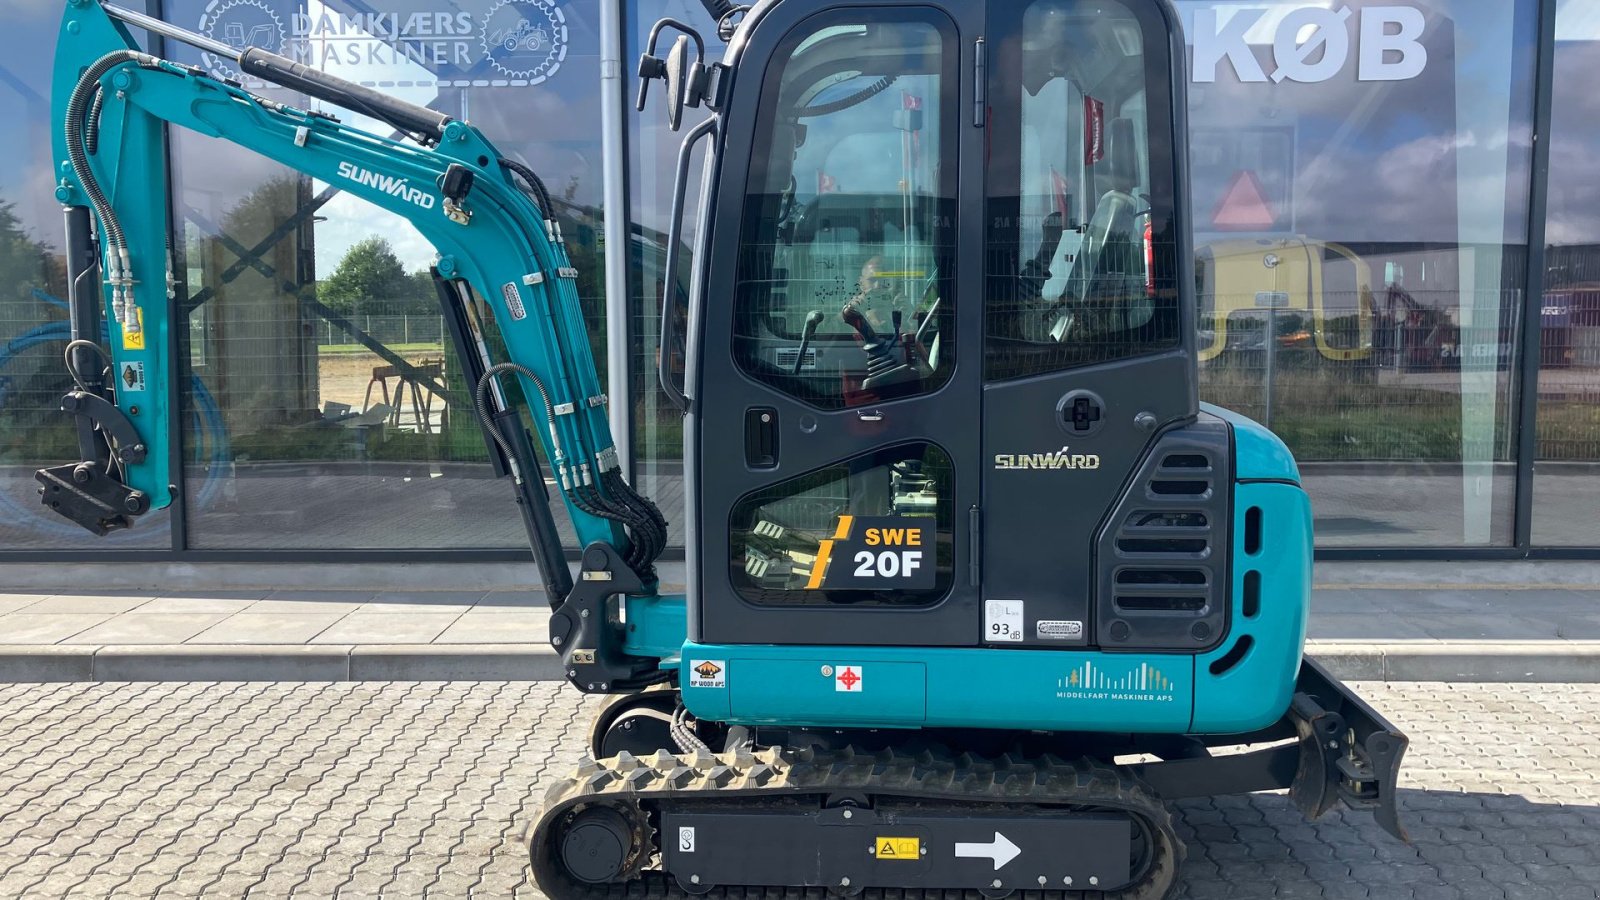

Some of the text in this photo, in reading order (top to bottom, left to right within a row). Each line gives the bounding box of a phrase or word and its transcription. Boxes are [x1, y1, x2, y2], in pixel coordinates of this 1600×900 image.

[291, 12, 473, 41] DAMKJÆRS
[291, 42, 472, 65] MASKINER
[1192, 5, 1428, 84] KØB
[337, 161, 435, 209] SUNWARD
[995, 446, 1100, 469] SUNWARD
[865, 528, 922, 545] SWE
[854, 551, 922, 577] 20F
[992, 623, 1010, 635] 93
[1009, 631, 1021, 640] dB
[1056, 691, 1109, 700] MIDDELFART
[1111, 693, 1154, 701] MASKINER
